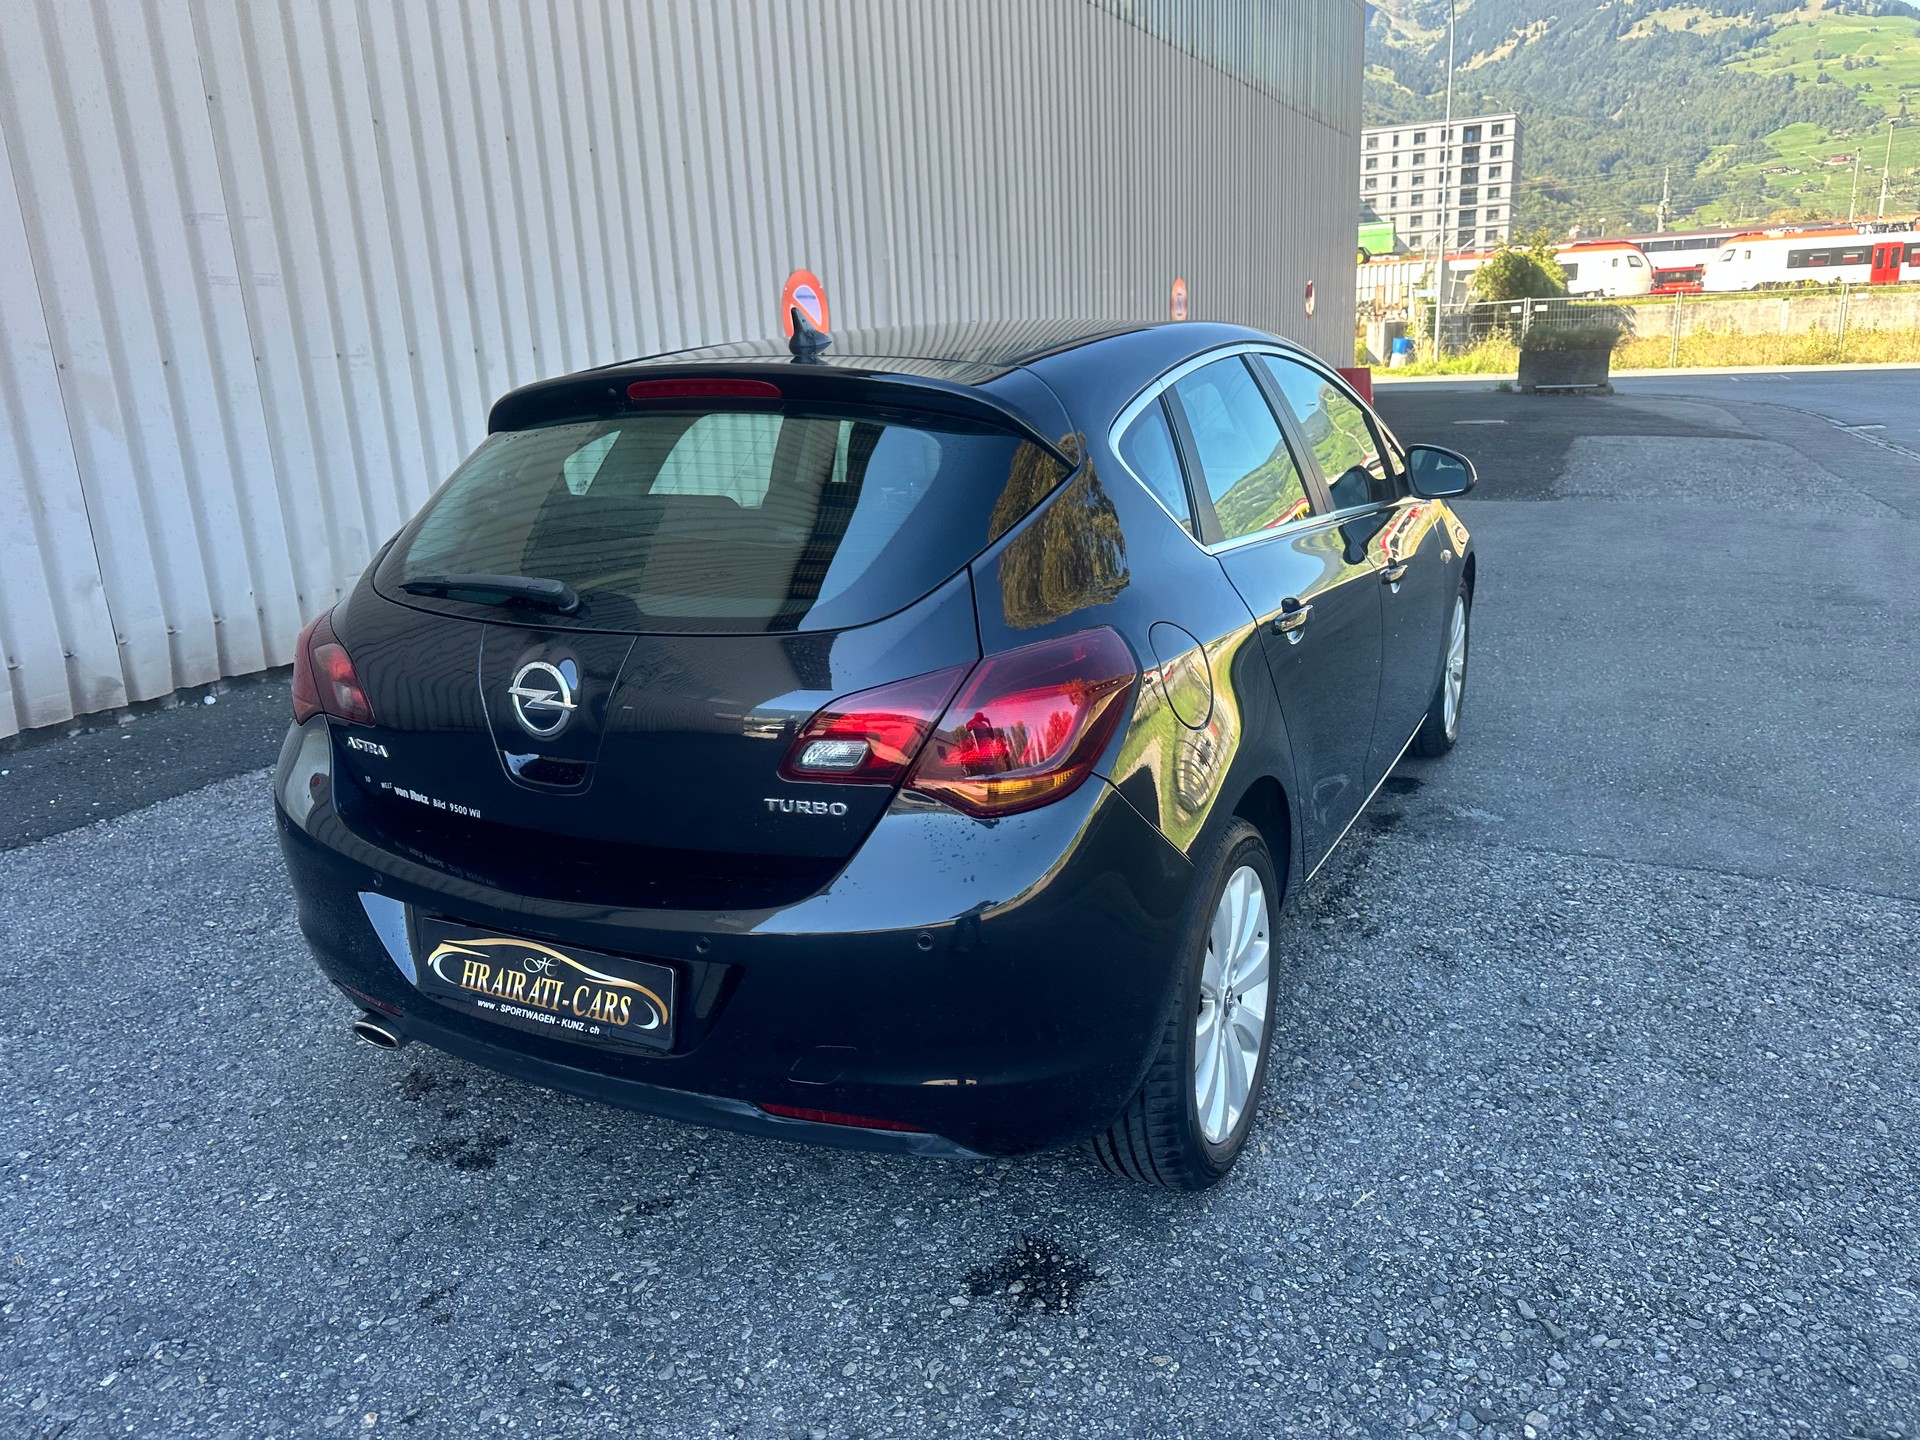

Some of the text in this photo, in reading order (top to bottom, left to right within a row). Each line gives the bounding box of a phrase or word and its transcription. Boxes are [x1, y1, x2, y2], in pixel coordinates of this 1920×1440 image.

[347, 736, 389, 758] ASTRA
[394, 786, 409, 799] von
[409, 789, 429, 805] Rotz
[449, 802, 468, 816] 9500
[468, 807, 481, 819] Wil
[763, 798, 848, 816] TURBO
[459, 959, 632, 1026] HRAIRATI-CARS
